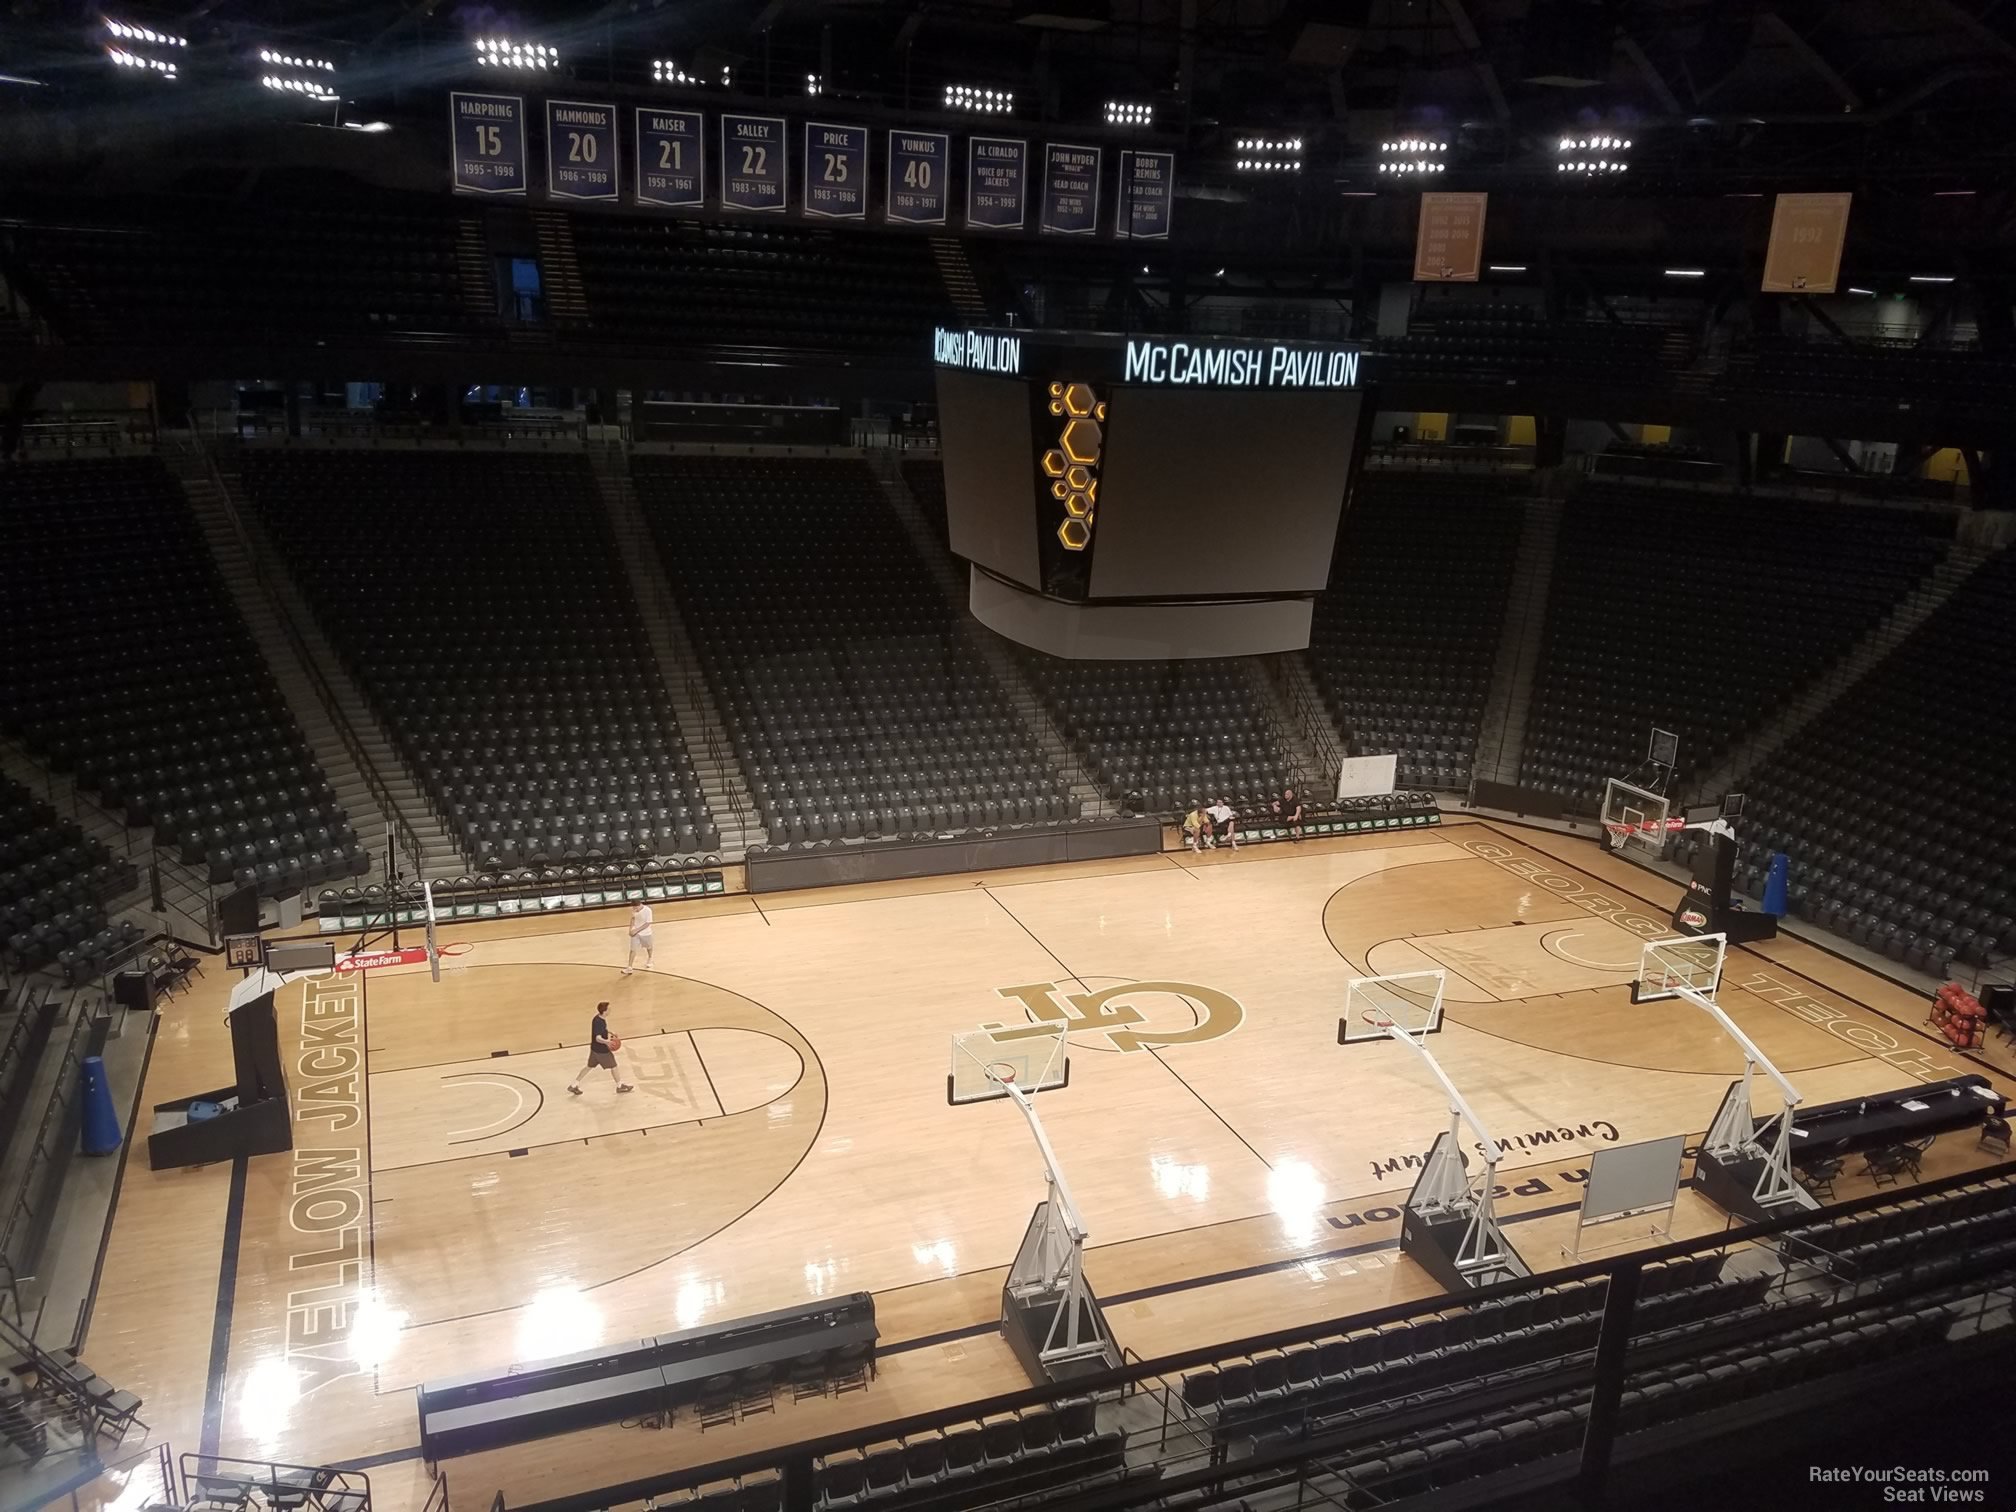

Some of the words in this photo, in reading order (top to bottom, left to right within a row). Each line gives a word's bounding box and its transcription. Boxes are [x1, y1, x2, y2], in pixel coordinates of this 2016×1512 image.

[461, 102, 512, 118] HARPRING
[556, 109, 606, 125] HAMMONDS
[652, 117, 685, 132] KAISER
[737, 124, 769, 138] SALLEY
[475, 125, 502, 156] 15
[823, 132, 849, 146] PRICE
[901, 139, 935, 153] YUNKUS
[568, 132, 597, 163] 20
[977, 145, 986, 156] AL
[988, 146, 1018, 158] CIRALDO
[659, 140, 681, 170] 21
[742, 146, 767, 175] 22
[1051, 152, 1070, 164] JOHN
[1071, 153, 1095, 166] HYDER
[465, 163, 484, 175] 1995
[494, 165, 514, 177] 1998
[824, 153, 848, 183] 25
[1135, 157, 1159, 169] BOBBY
[559, 170, 579, 182] 1986
[588, 172, 607, 184] 1989
[904, 160, 931, 189] 40
[977, 167, 995, 177] VOICE
[996, 168, 1004, 177] OF
[1005, 169, 1017, 178] THE
[648, 176, 666, 189] 1958
[675, 178, 692, 190] 1961
[732, 182, 750, 193] 1983
[758, 183, 776, 195] 1986
[984, 177, 1010, 187] JACKETS
[1069, 181, 1089, 191] COACH
[814, 189, 831, 200] 1983
[839, 191, 856, 203] 1986
[1144, 186, 1163, 196] COACH
[897, 195, 914, 207] 1968
[921, 197, 937, 209] 1971
[966, 330, 1020, 374] PAVILION
[1268, 347, 1359, 386] PAVILION
[1697, 883, 1712, 896] PNC
[1741, 972, 1967, 1083] TECH
[286, 1147, 364, 1400] YELLOW
